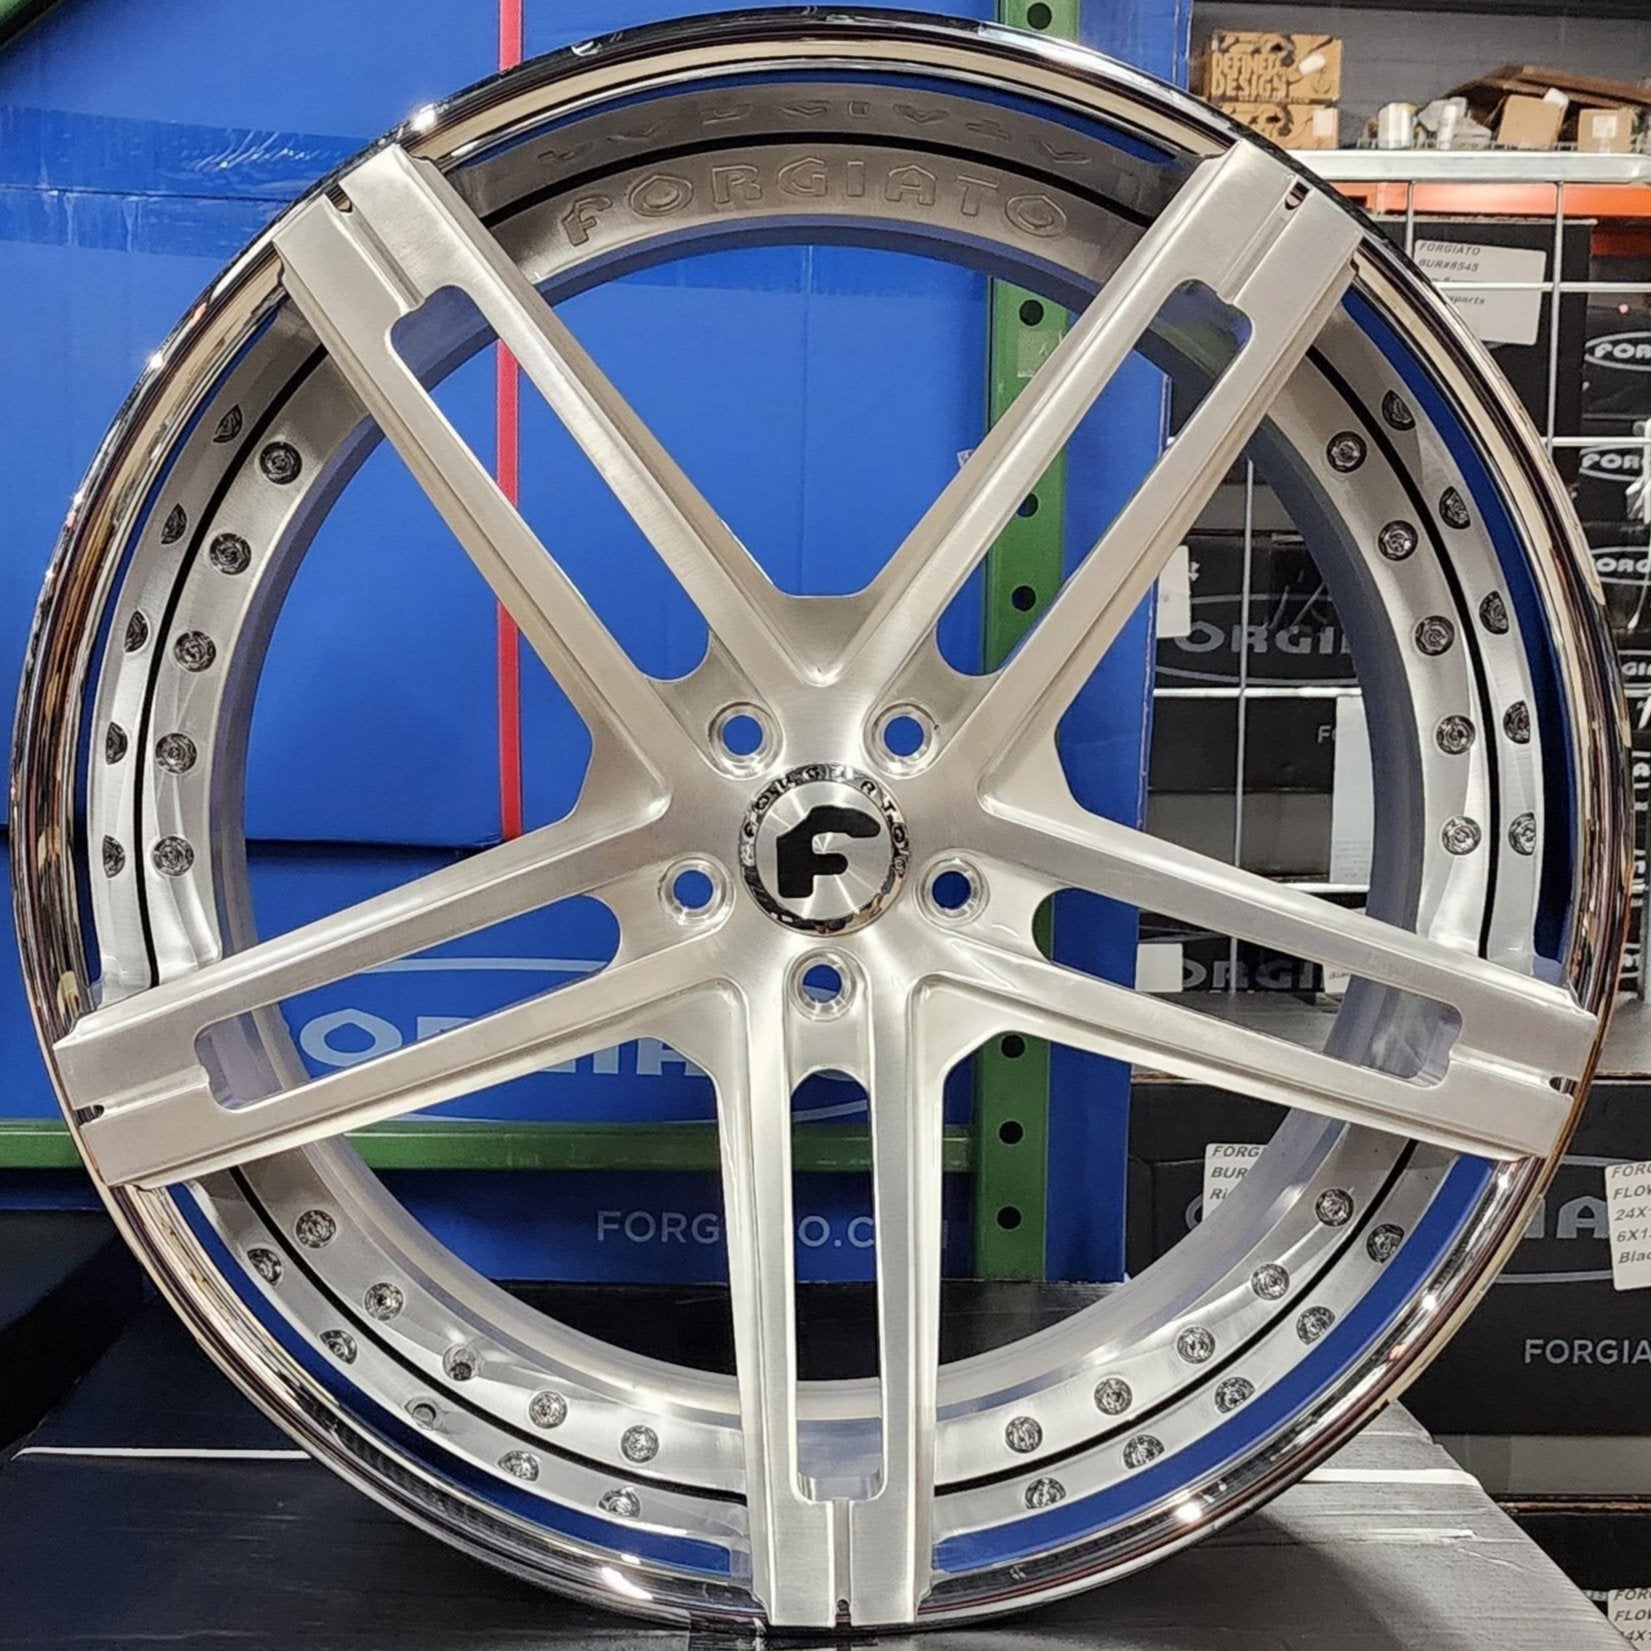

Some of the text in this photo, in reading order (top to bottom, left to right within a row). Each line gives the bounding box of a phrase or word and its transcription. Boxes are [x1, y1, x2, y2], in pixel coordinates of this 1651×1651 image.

[561, 157, 1068, 248] FORGIATO
[1419, 241, 1481, 256] FORGIATO
[1582, 453, 1641, 469] FOR
[1211, 1145, 1260, 1158] FORG
[1210, 1166, 1249, 1179] BUR
[1613, 1205, 1651, 1222] 24X
[1616, 1227, 1651, 1243] 6X1
[1524, 1338, 1651, 1365] FORGIA
[1613, 1587, 1651, 1602] FOR
